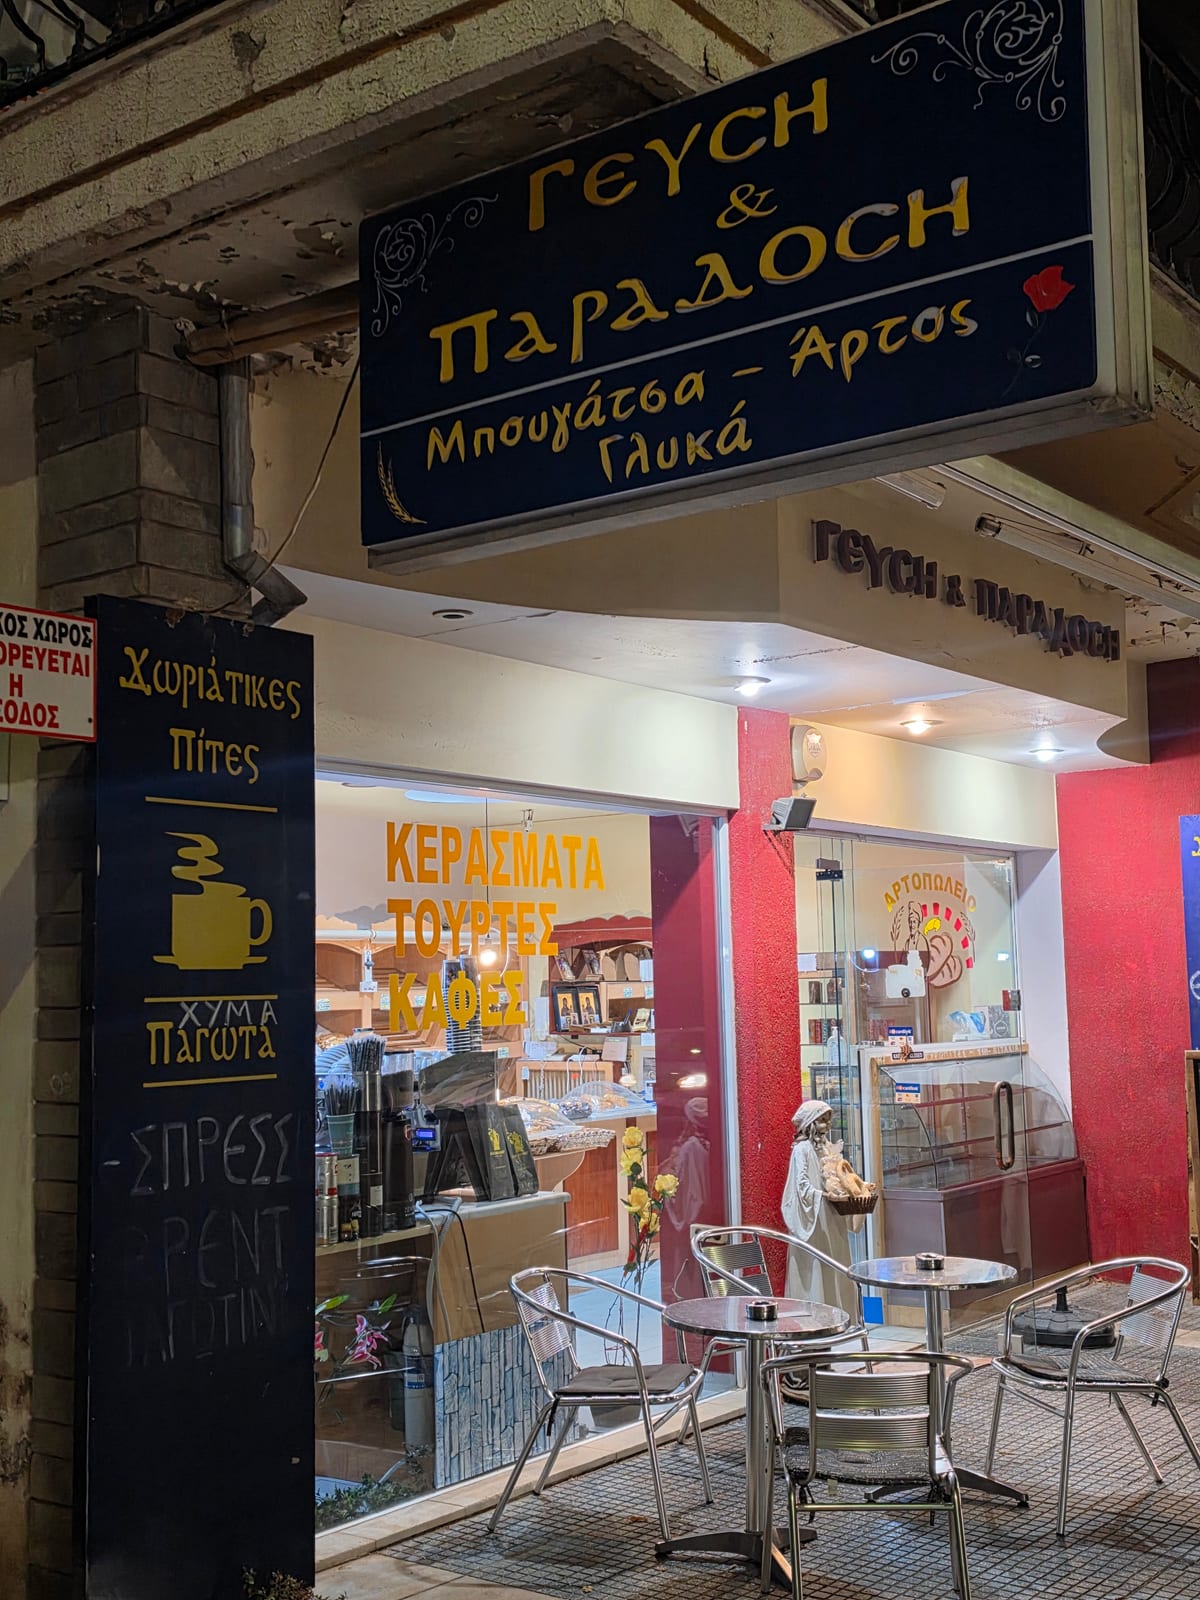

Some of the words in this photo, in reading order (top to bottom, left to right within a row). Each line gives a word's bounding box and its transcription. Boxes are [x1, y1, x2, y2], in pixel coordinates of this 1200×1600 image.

[716, 183, 778, 230] &
[789, 298, 979, 384] Άρτος
[598, 399, 753, 484] Γλυκά
[942, 573, 967, 609] &
[33, 617, 94, 649] ΧΩΡΟΣ
[9, 672, 24, 698] Η
[0, 698, 60, 729] ΟΔΟΣ
[386, 821, 606, 891] ΚΕΡΑΣΜΑΤΑ
[883, 872, 977, 913] ΑΡΤΟΠΩΛΕΙΟ
[386, 898, 560, 958] ΤΟΥΡΤΕΣ
[178, 1000, 278, 1028] ΧΥΜΑ
[388, 970, 528, 1032] ΚΑΦΕΣ
